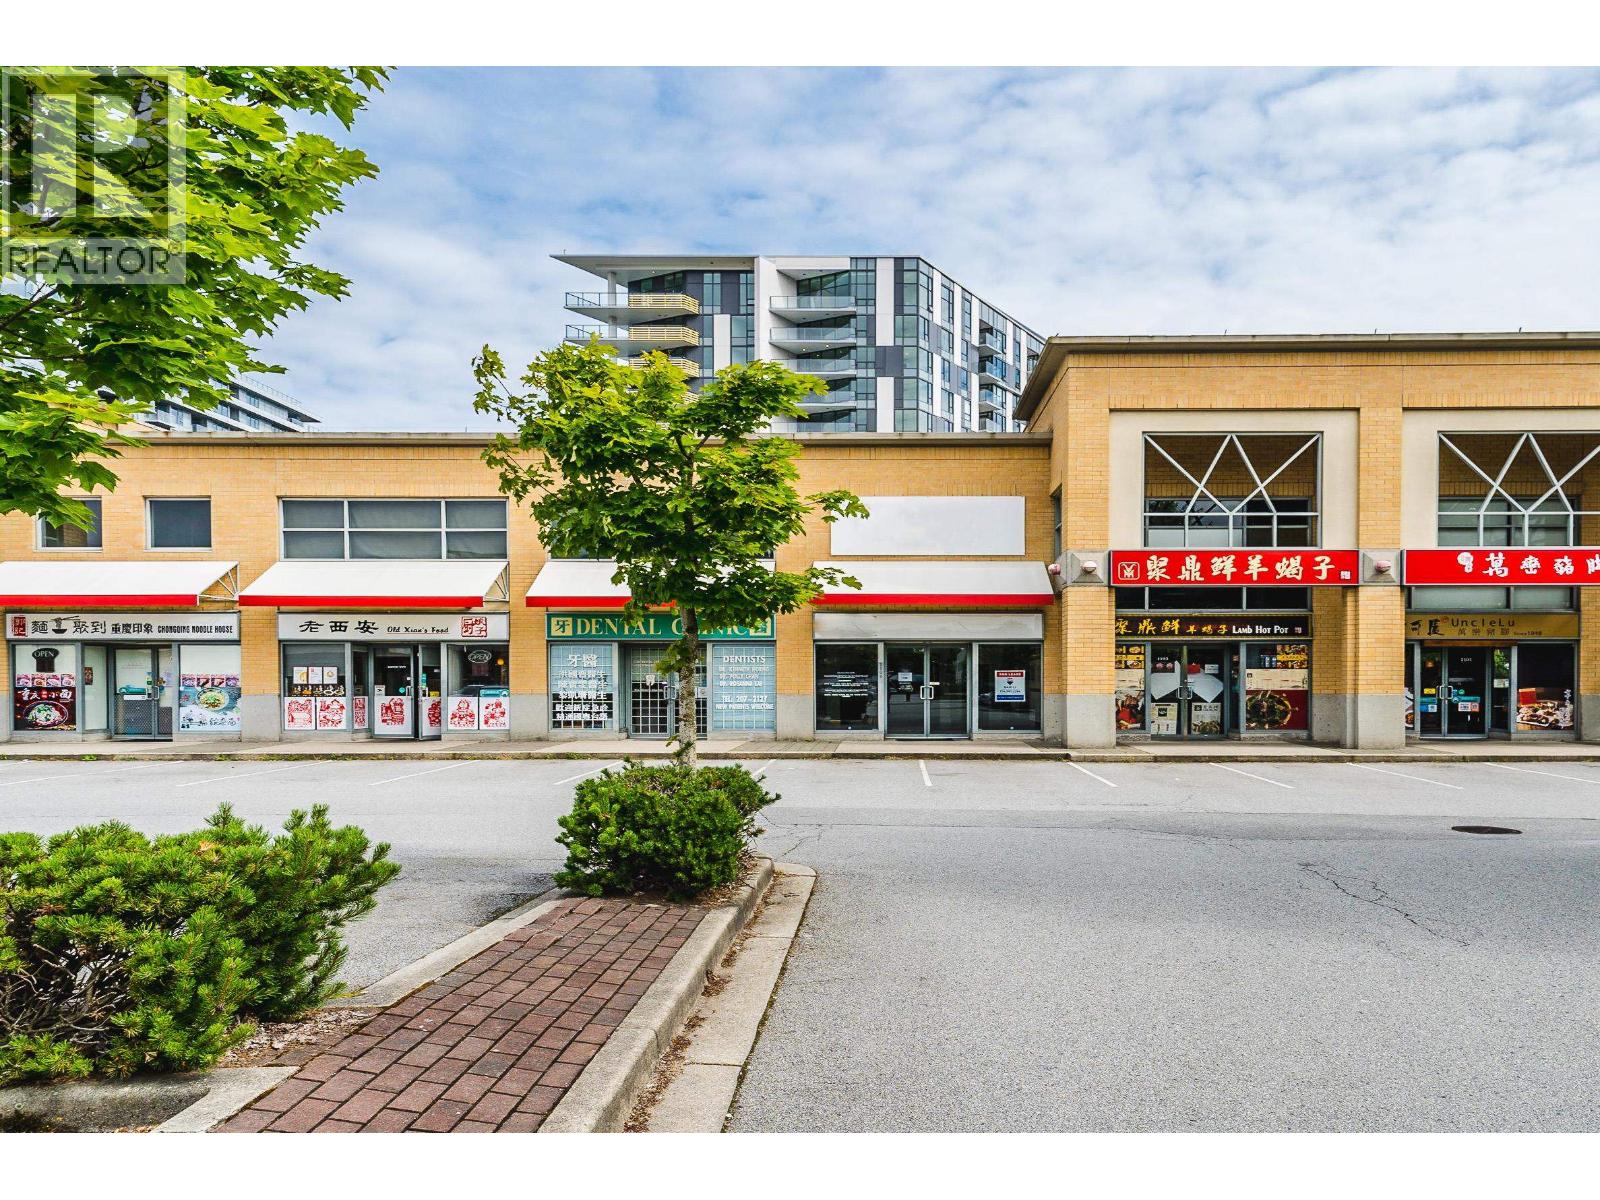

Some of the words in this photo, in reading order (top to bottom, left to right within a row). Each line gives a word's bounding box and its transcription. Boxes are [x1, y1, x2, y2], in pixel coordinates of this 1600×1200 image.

[158, 625, 191, 633] CHONGQING
[192, 625, 214, 633] NOODLE
[215, 625, 233, 633] HOUSE
[299, 620, 379, 634] 老西安
[555, 619, 570, 633] 牙
[34, 650, 55, 658] OPEN
